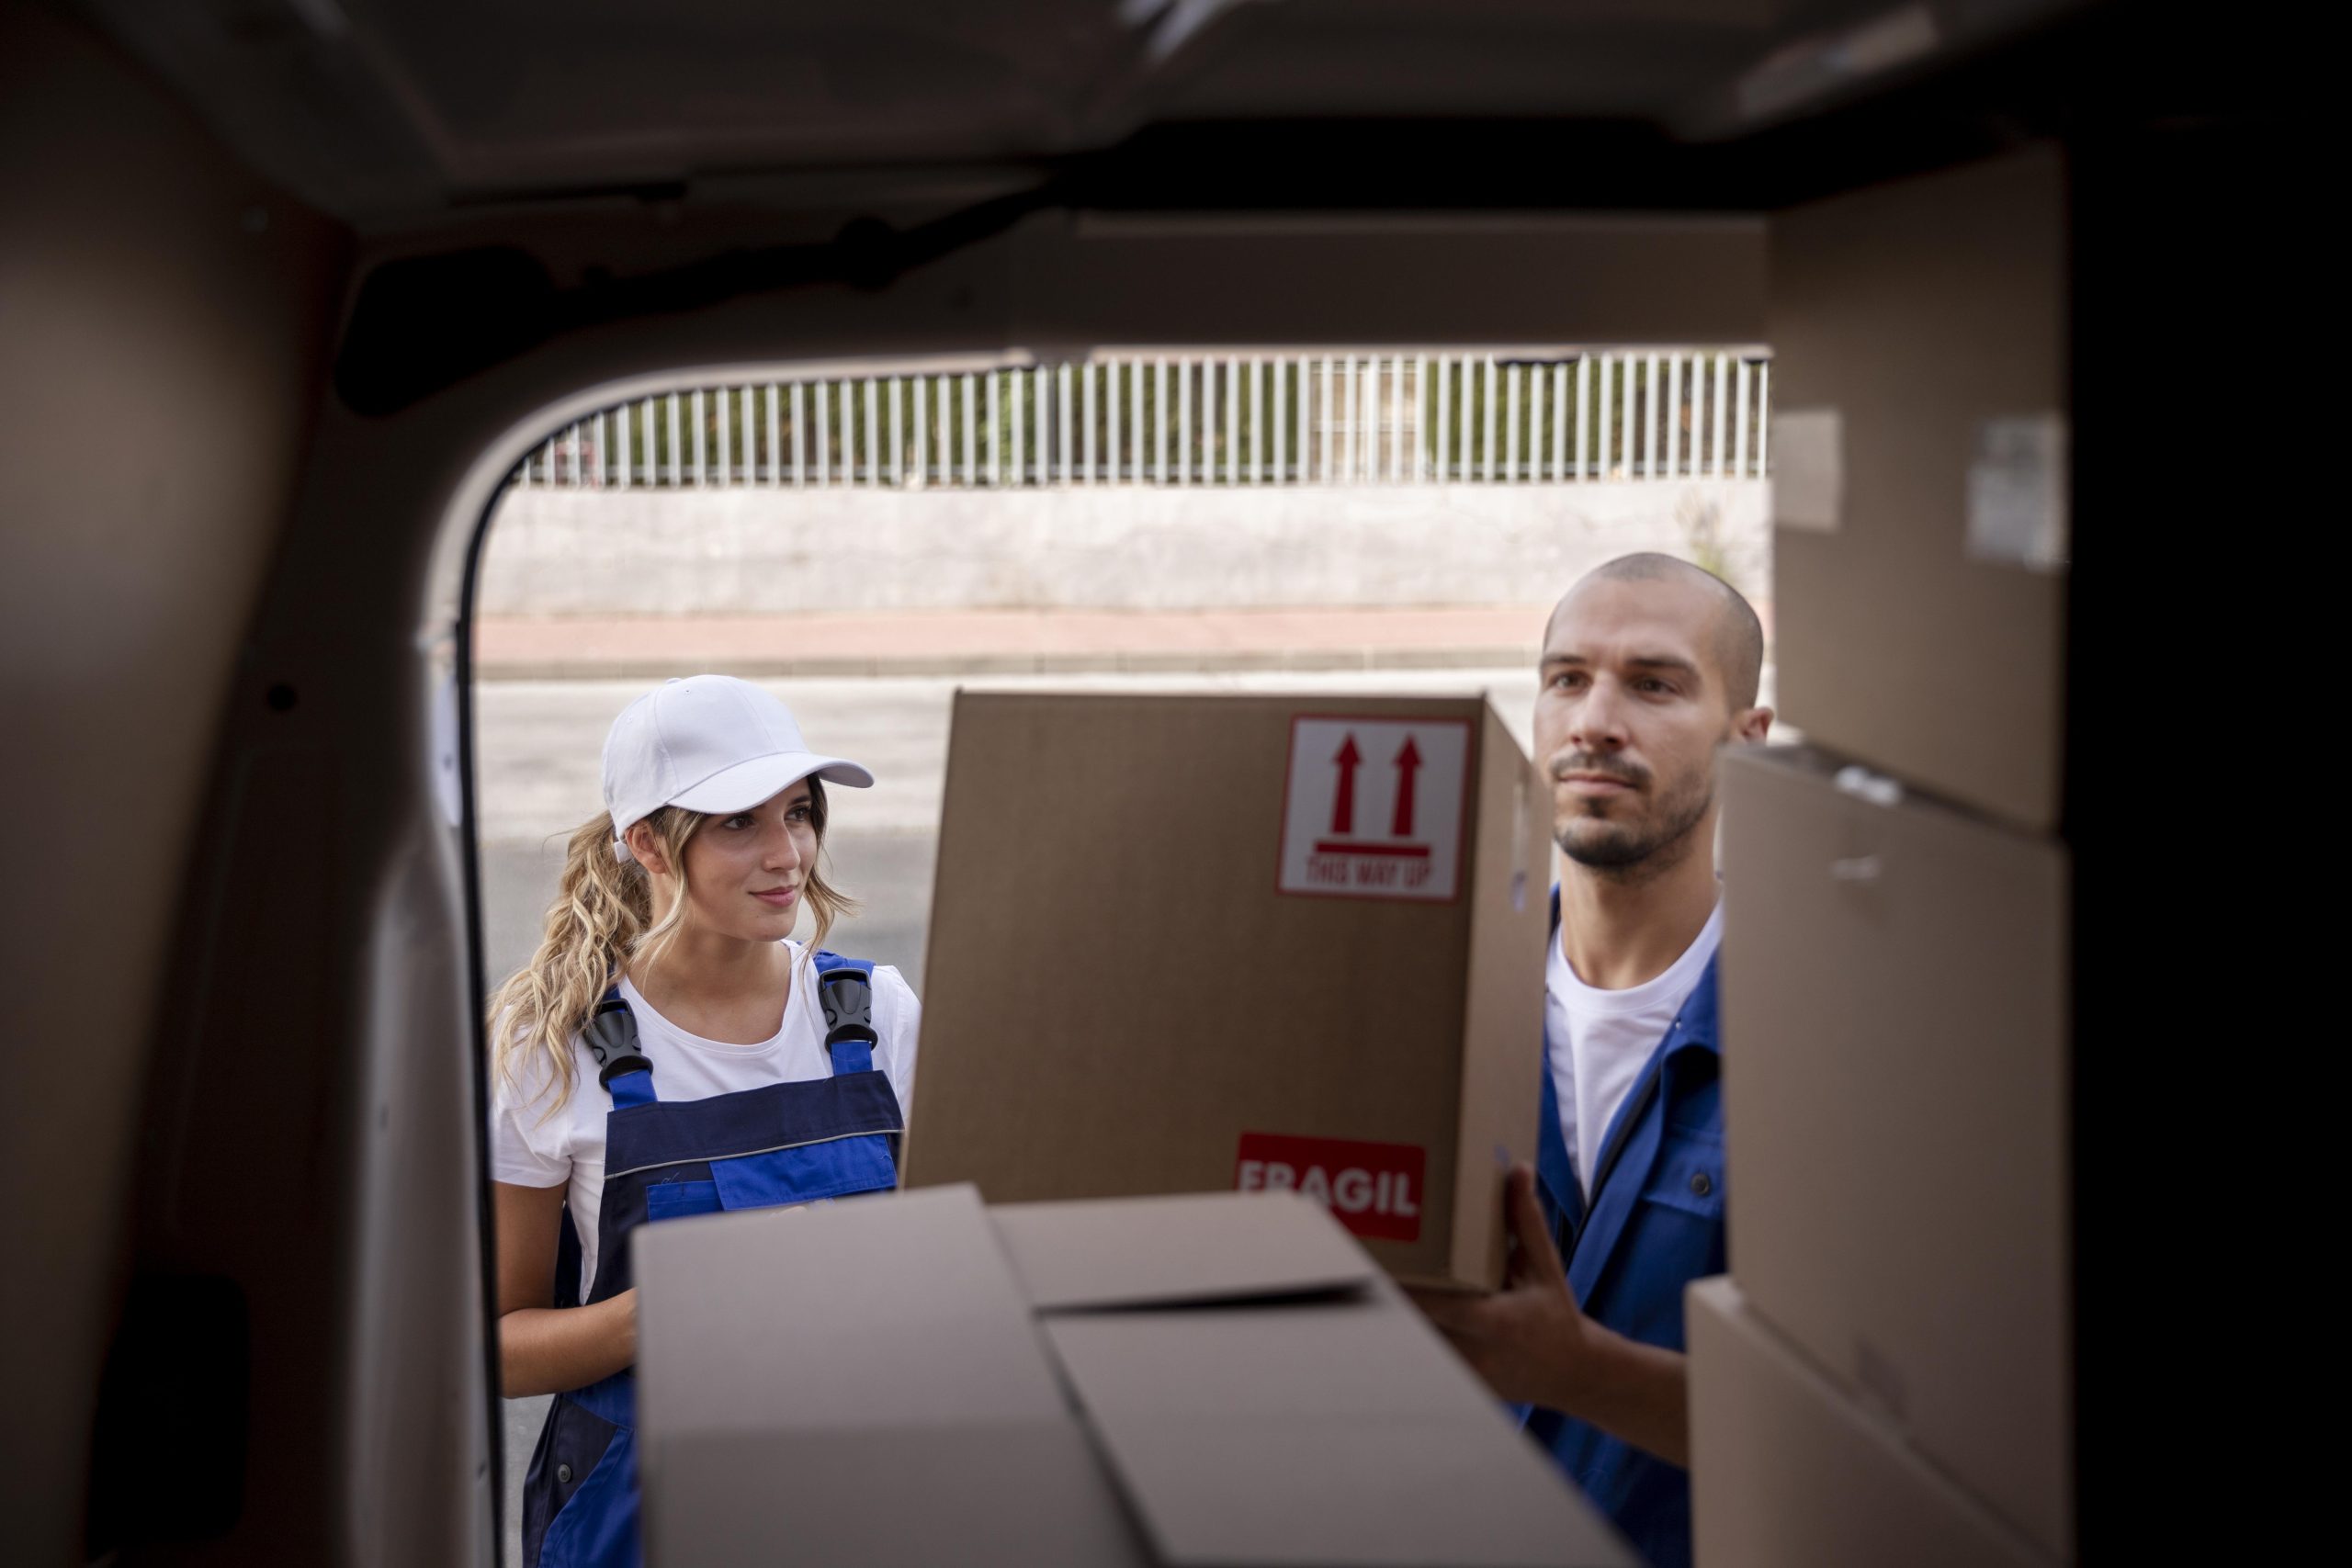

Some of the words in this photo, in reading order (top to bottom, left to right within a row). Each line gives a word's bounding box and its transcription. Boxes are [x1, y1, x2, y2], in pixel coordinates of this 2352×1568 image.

[1306, 854, 1350, 885] THIS
[1356, 858, 1396, 886] WAY
[1403, 860, 1430, 888] UP
[1238, 1159, 1419, 1217] FRAGIL
